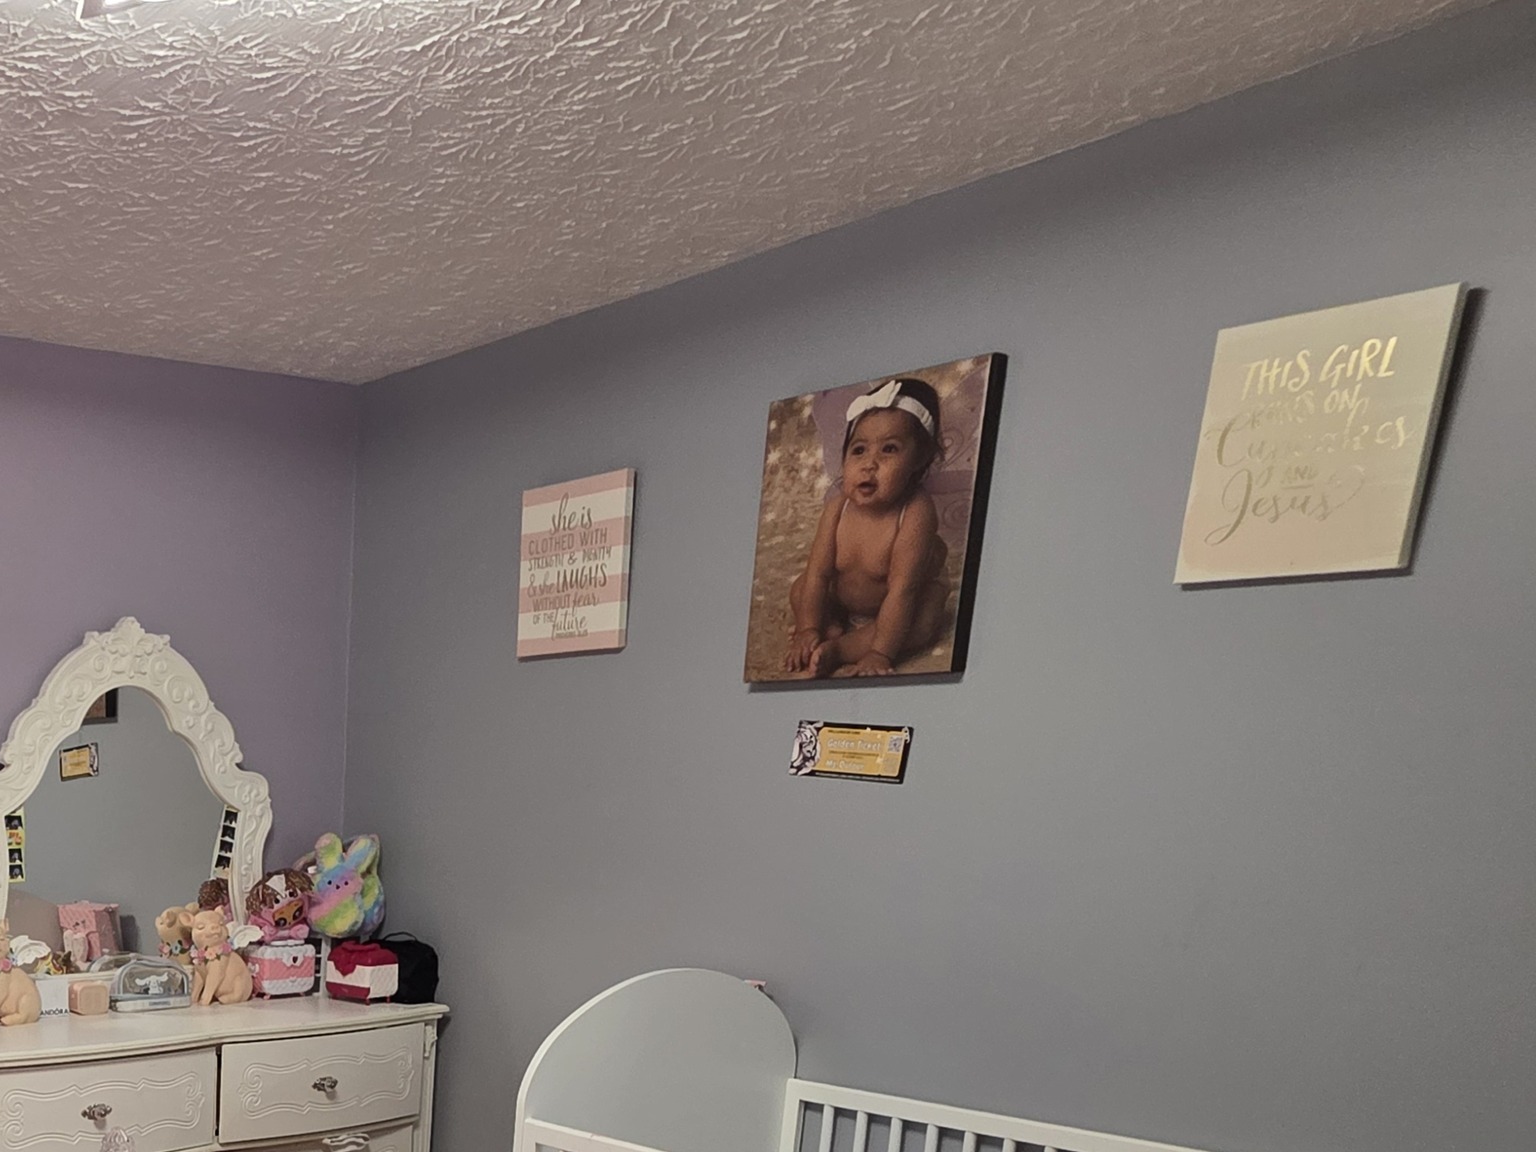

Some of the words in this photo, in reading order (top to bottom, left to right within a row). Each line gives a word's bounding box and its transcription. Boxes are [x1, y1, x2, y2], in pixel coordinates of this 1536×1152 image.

[1241, 349, 1311, 401] THIS
[1319, 336, 1398, 388] GIRL
[549, 492, 579, 536] she
[581, 506, 593, 530] is
[1204, 467, 1340, 546] Jesus
[528, 533, 574, 556] CLOTHED
[579, 527, 608, 547] WITH
[557, 563, 607, 593] LAUGHS
[532, 594, 571, 613] WITHOUT
[572, 592, 599, 617] fear
[551, 608, 587, 641] future
[40, 1007, 69, 1017] ANDORA
